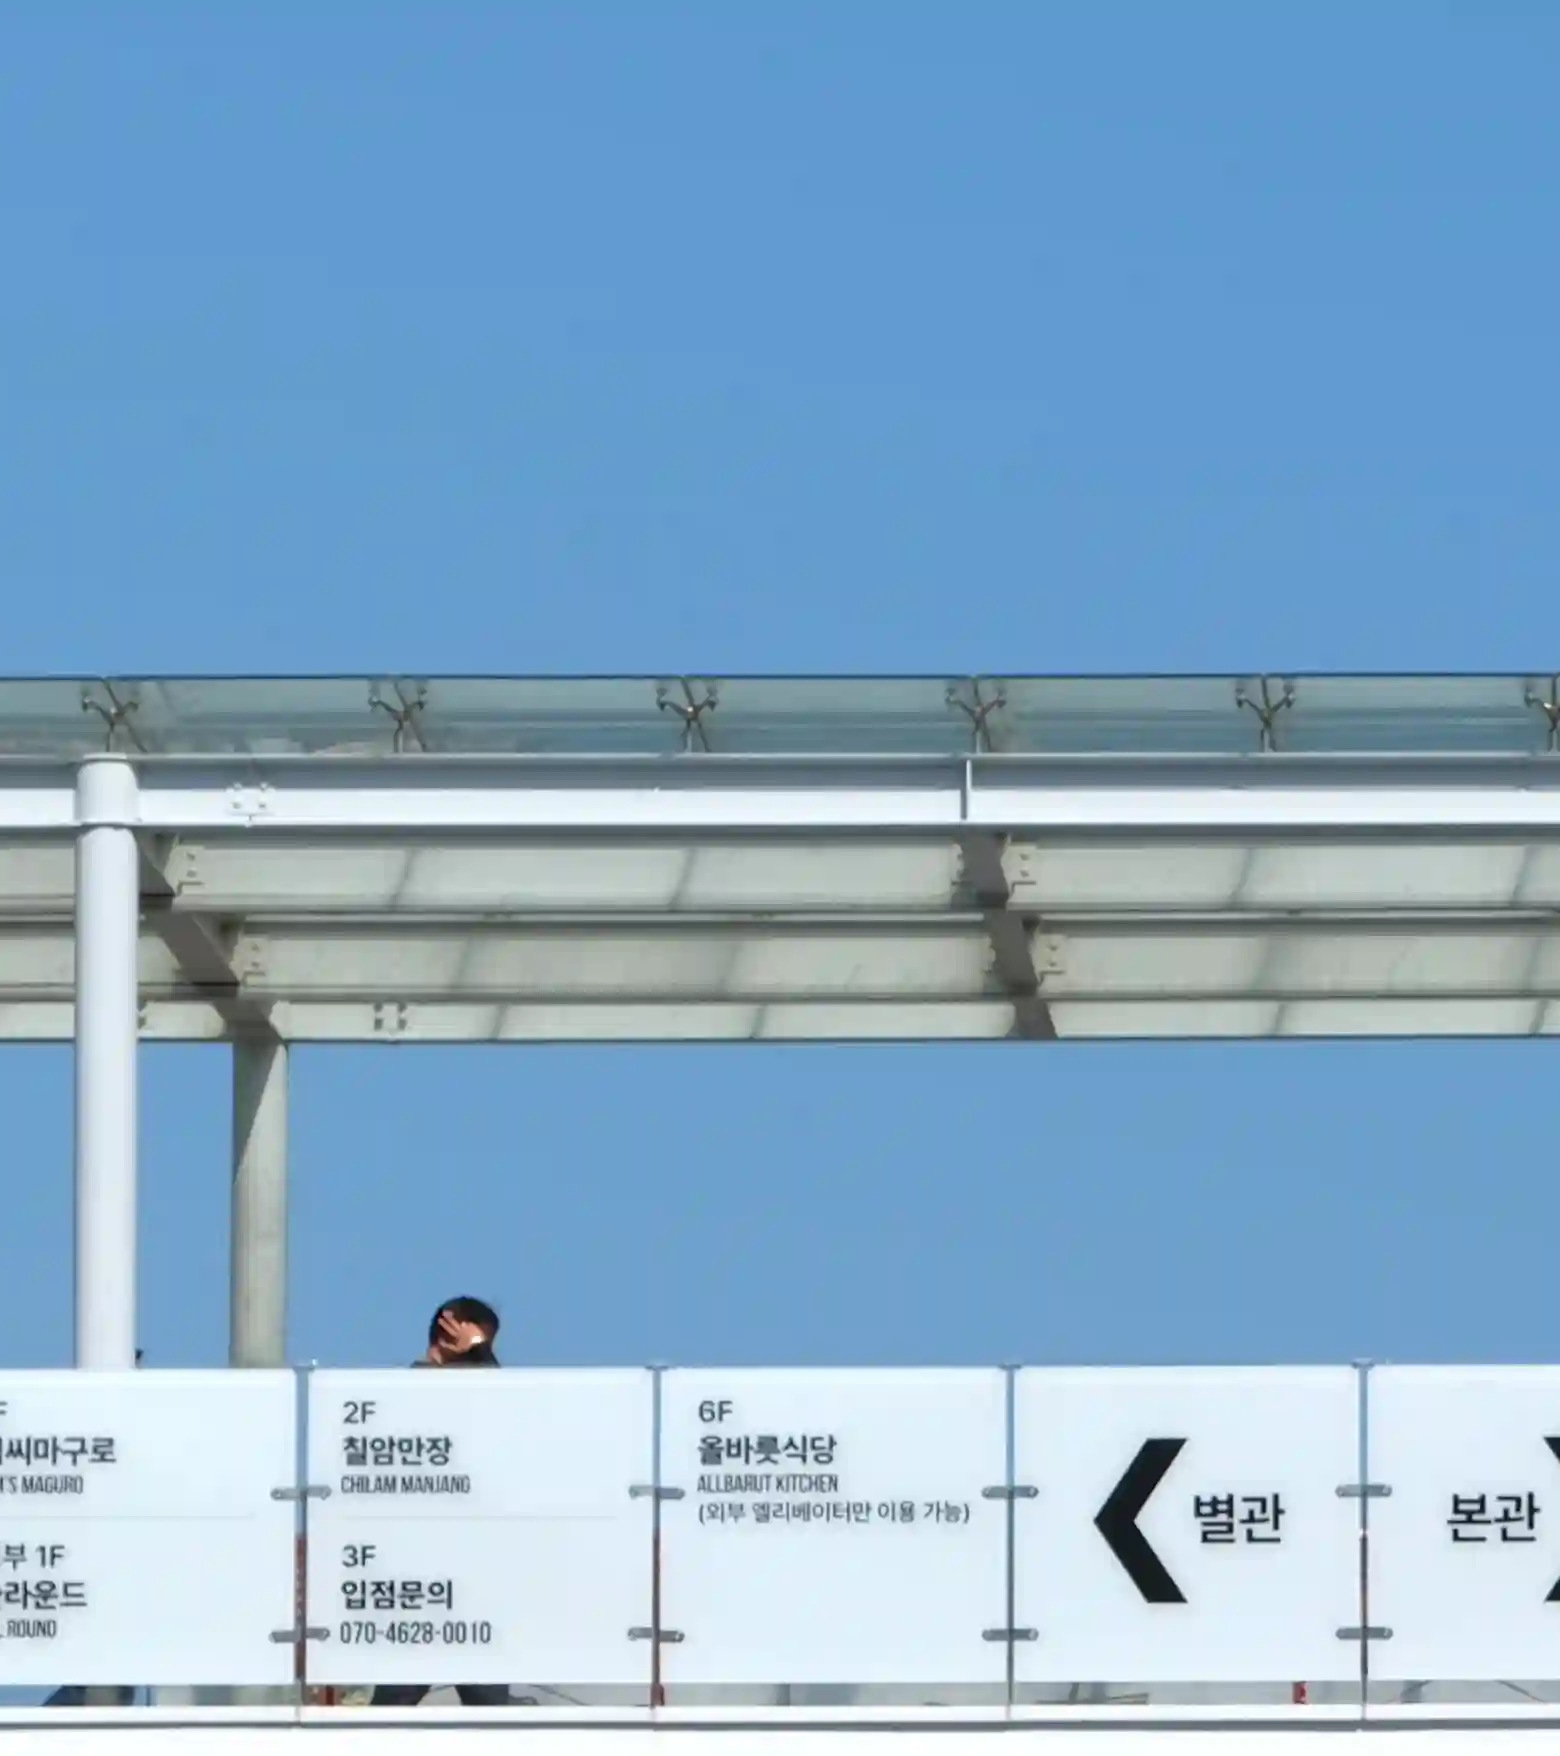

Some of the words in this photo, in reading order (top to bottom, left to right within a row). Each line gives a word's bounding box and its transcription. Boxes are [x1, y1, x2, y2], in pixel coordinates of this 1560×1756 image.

[344, 1401, 376, 1424] 2F
[699, 1400, 732, 1423] 6F
[344, 1436, 452, 1466] 칠암만장
[698, 1435, 837, 1465] 올바릇식당
[21, 1475, 83, 1494] MAGURO
[341, 1475, 397, 1493] CHILAM
[401, 1475, 470, 1494] MANJANG
[697, 1474, 772, 1493] ALLBARUT
[776, 1474, 838, 1493] KITCHEN
[699, 1502, 746, 1525] (외부
[752, 1501, 872, 1523] 엘리베이터만
[878, 1501, 915, 1523] 이용
[924, 1500, 970, 1524] 가능)
[1194, 1493, 1285, 1543] 별관
[1447, 1492, 1540, 1542] 본관
[36, 1545, 65, 1568] 1F
[342, 1545, 376, 1568] 3F
[341, 1580, 452, 1610] 입점문의
[7, 1619, 57, 1638] ROUND
[340, 1620, 491, 1644] 070-4628-0010
